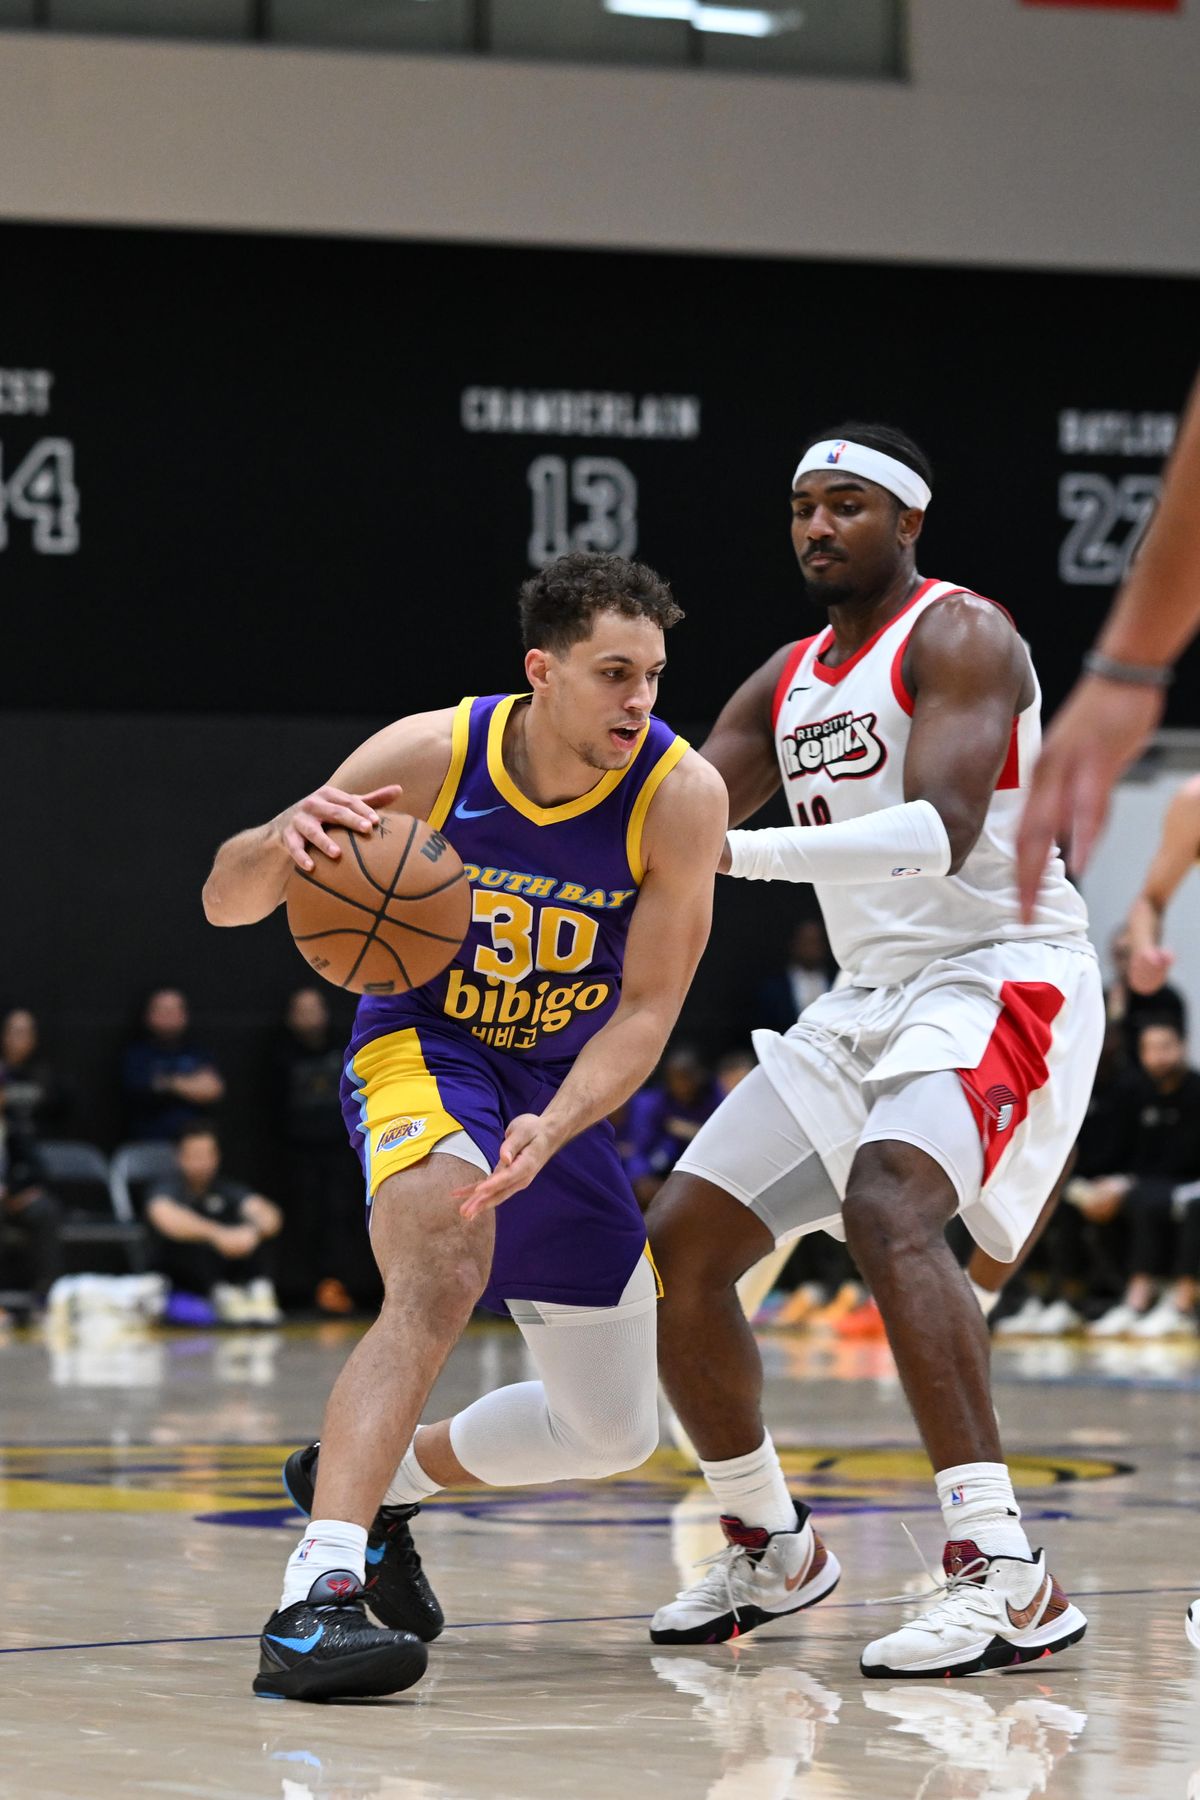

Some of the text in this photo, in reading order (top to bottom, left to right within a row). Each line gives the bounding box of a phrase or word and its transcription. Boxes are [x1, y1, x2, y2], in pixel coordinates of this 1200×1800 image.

[460, 386, 700, 440] CHAMBERLAIN
[0, 437, 79, 554] 4
[527, 454, 638, 567] 13
[463, 863, 635, 909] OUTH BAY
[472, 889, 599, 984] 30
[443, 969, 609, 1033] bibigo
[472, 1025, 538, 1049] 비비고
